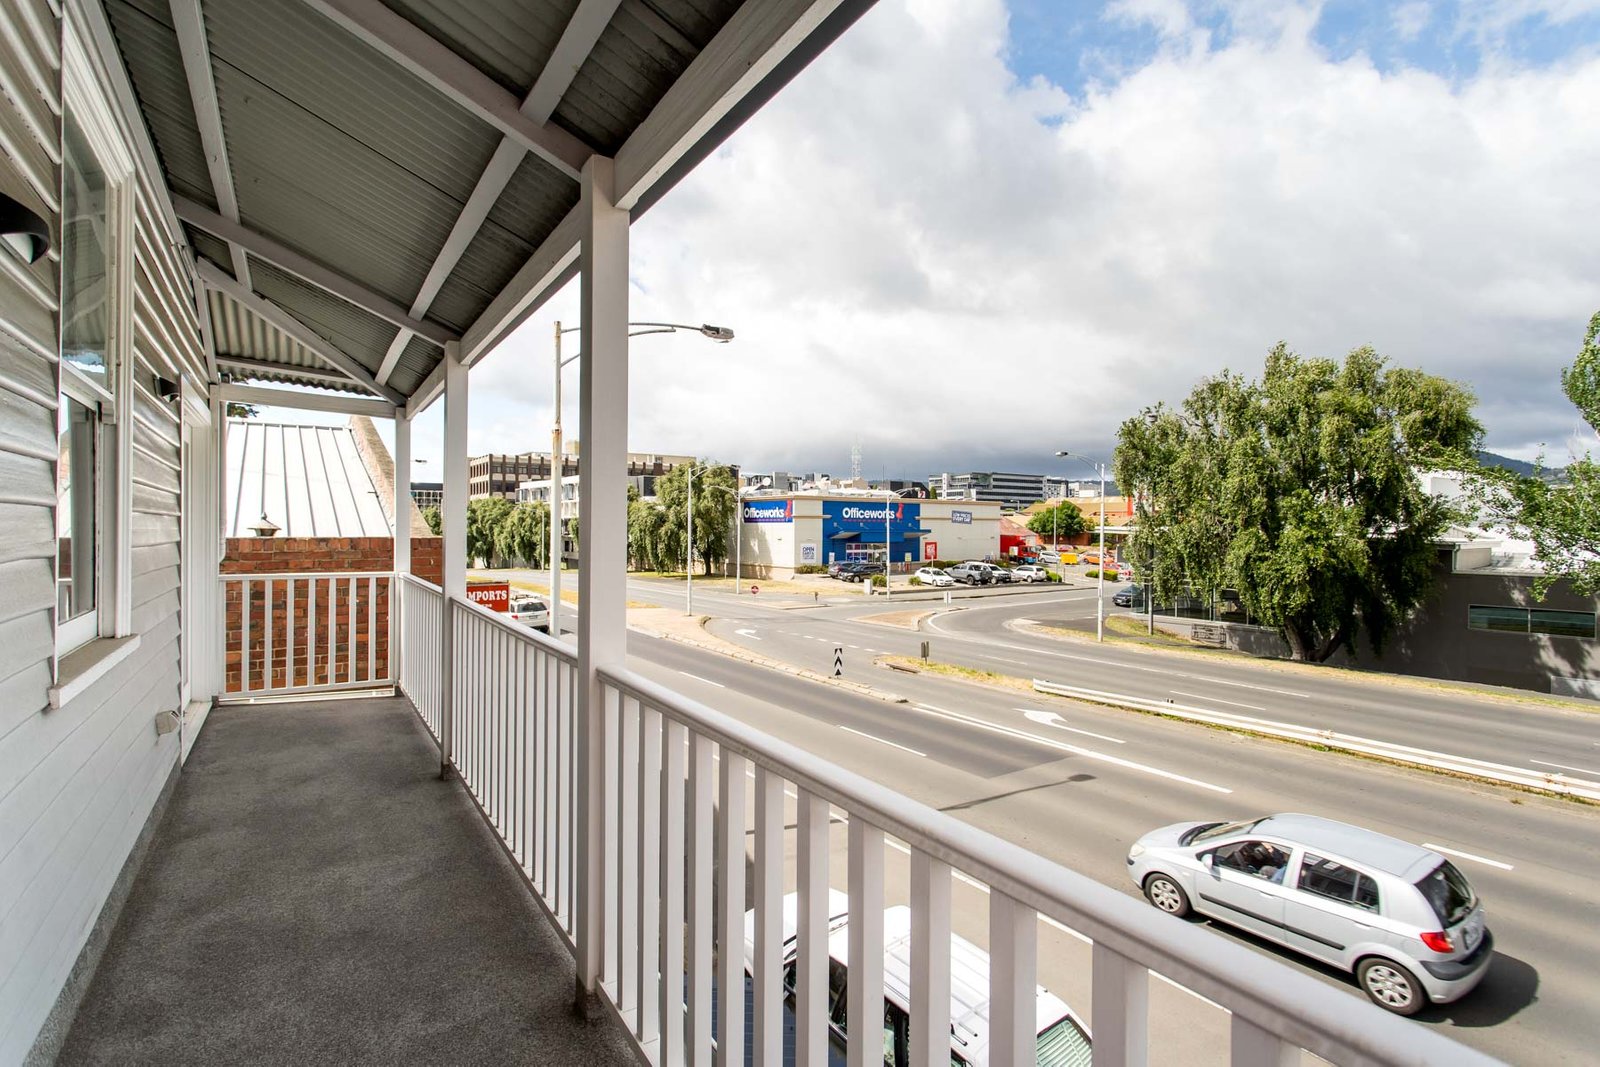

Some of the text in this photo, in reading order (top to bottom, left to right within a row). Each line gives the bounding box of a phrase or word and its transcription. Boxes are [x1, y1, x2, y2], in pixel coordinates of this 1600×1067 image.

[744, 507, 784, 518] Officeworks
[842, 507, 895, 519] Officeworks
[467, 590, 507, 602] MPORTS
